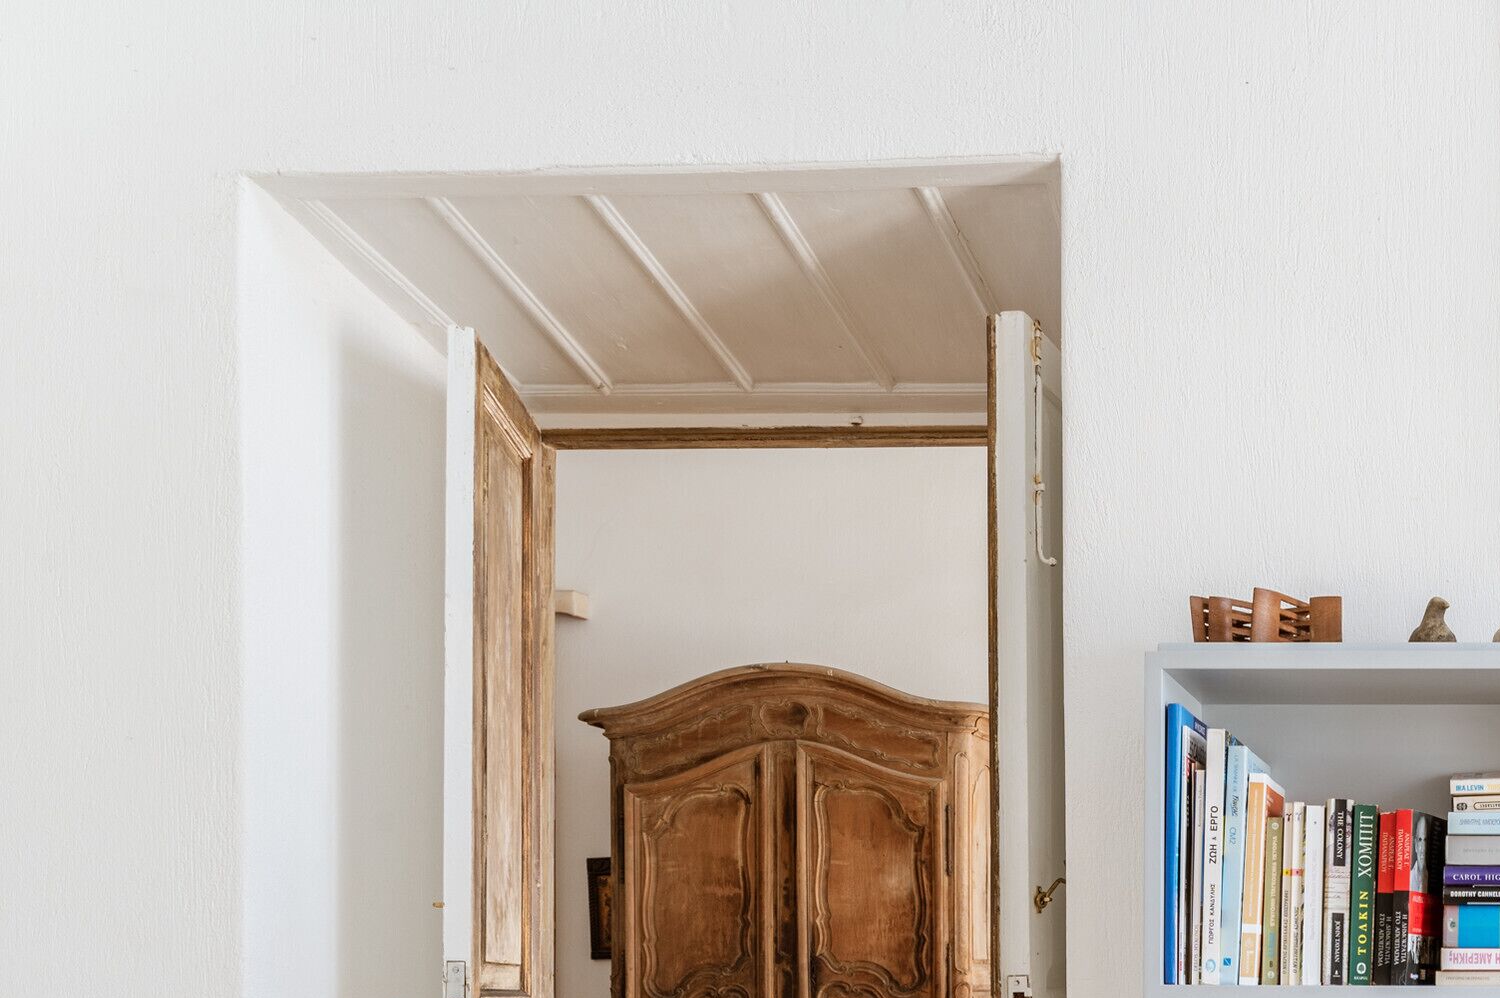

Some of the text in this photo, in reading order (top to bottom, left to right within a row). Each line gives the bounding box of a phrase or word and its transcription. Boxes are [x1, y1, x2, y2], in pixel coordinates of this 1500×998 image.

[1467, 784, 1485, 792] LEVIN
[1210, 805, 1219, 832] ΕΡΓΟ
[1229, 826, 1238, 845] CM2
[1336, 828, 1344, 859] COLONY
[1208, 844, 1218, 865] ΖΩΗ
[1396, 828, 1404, 871] ΠΑΠΑΝΔΡΕΟΥ
[1357, 811, 1375, 956] ΧΟΜΠΙΤ ΤΟΛΚΙΝ
[1452, 872, 1483, 881] CAROL
[1449, 890, 1478, 898] DOROTHY
[1400, 921, 1409, 963] ΔΗΜΟΚΡΑΤΙΑ
[1448, 950, 1493, 965] ΑΜΕΡΙΚΗ;
